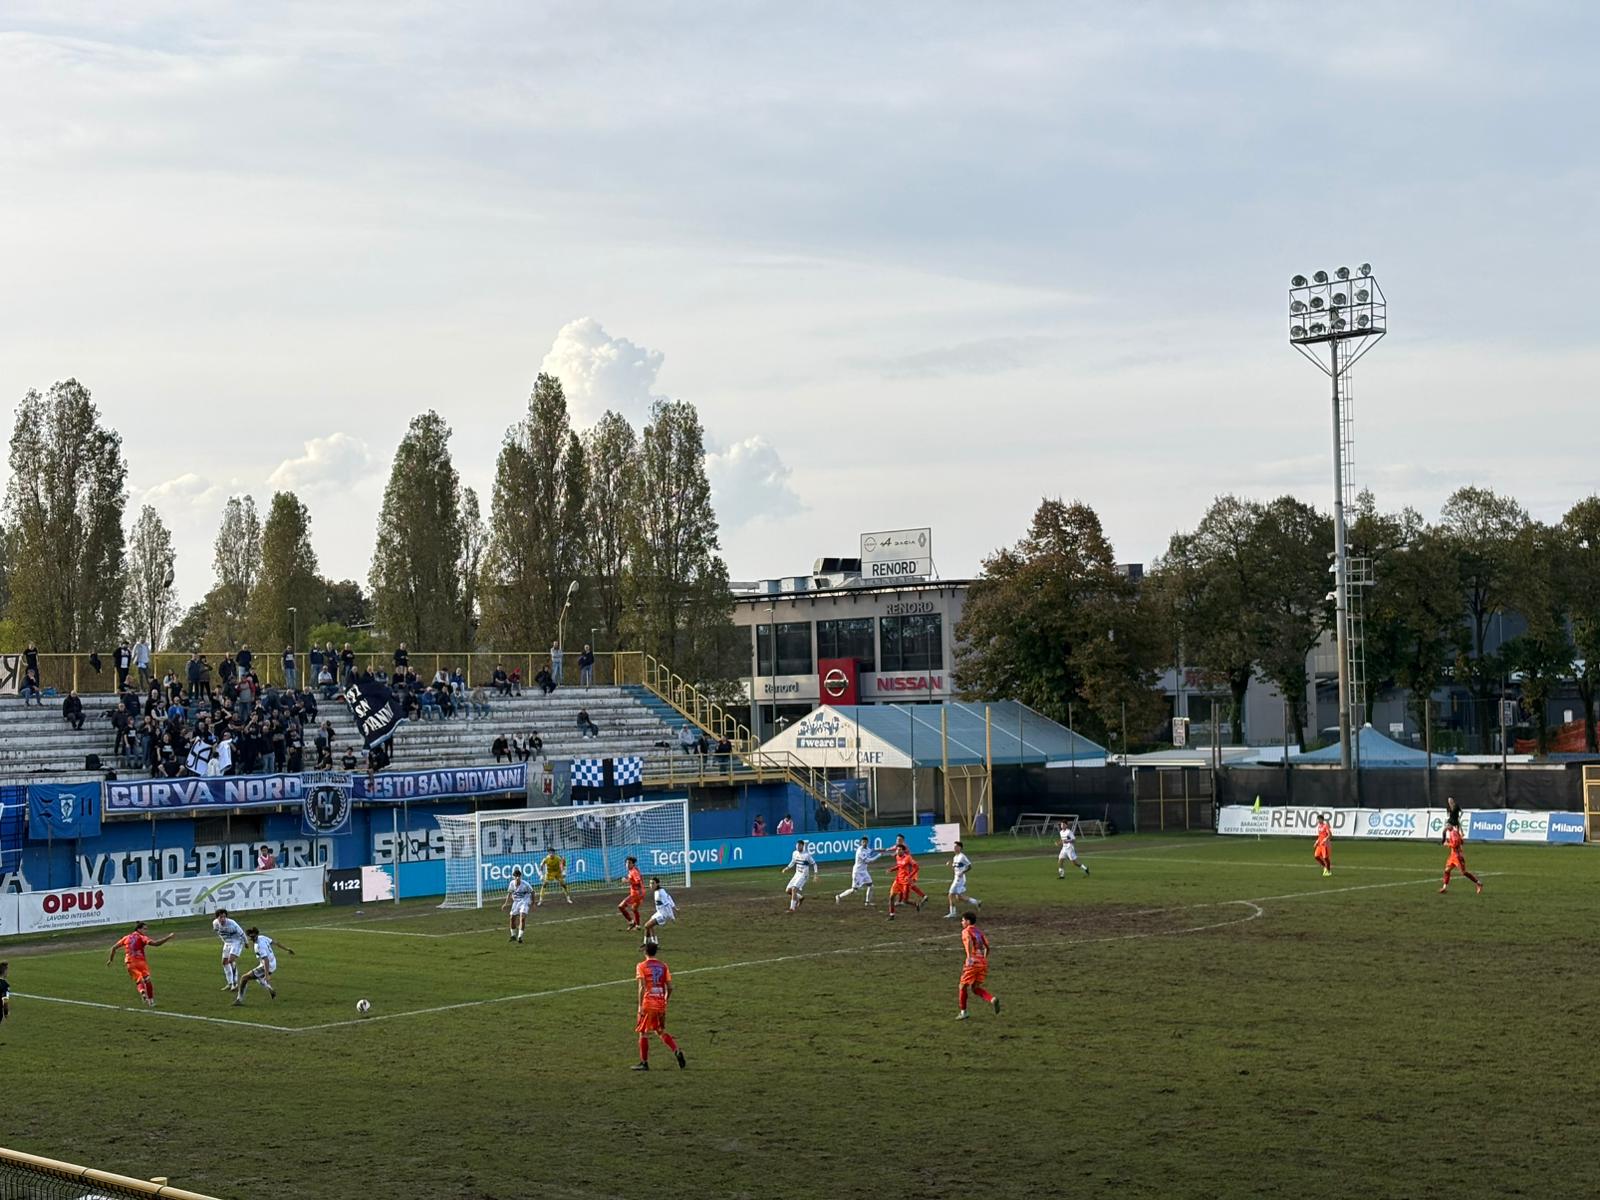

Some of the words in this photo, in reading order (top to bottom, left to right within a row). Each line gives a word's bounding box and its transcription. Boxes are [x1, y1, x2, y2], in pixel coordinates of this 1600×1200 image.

[872, 561, 917, 576] RENORD
[887, 601, 934, 615] RENORD
[764, 681, 799, 694] Renord
[877, 676, 943, 691] NISSAN
[800, 738, 836, 748] #weare
[364, 776, 414, 798] SESTO
[418, 773, 453, 794] SAN
[456, 768, 521, 792] GIOVANNI
[111, 780, 215, 807] CURVA
[224, 777, 300, 802] NORD
[1271, 810, 1345, 829] RENORD
[1382, 813, 1416, 828] GSK
[1474, 821, 1502, 831] Milano
[1521, 820, 1547, 830] BCC
[1552, 823, 1583, 833] Milano
[333, 879, 360, 891] 11:22
[156, 877, 299, 908] KEASYFIT
[43, 889, 105, 914] OPUS
[47, 913, 70, 922] LAVORO
[71, 910, 101, 919] INTEGRATO
